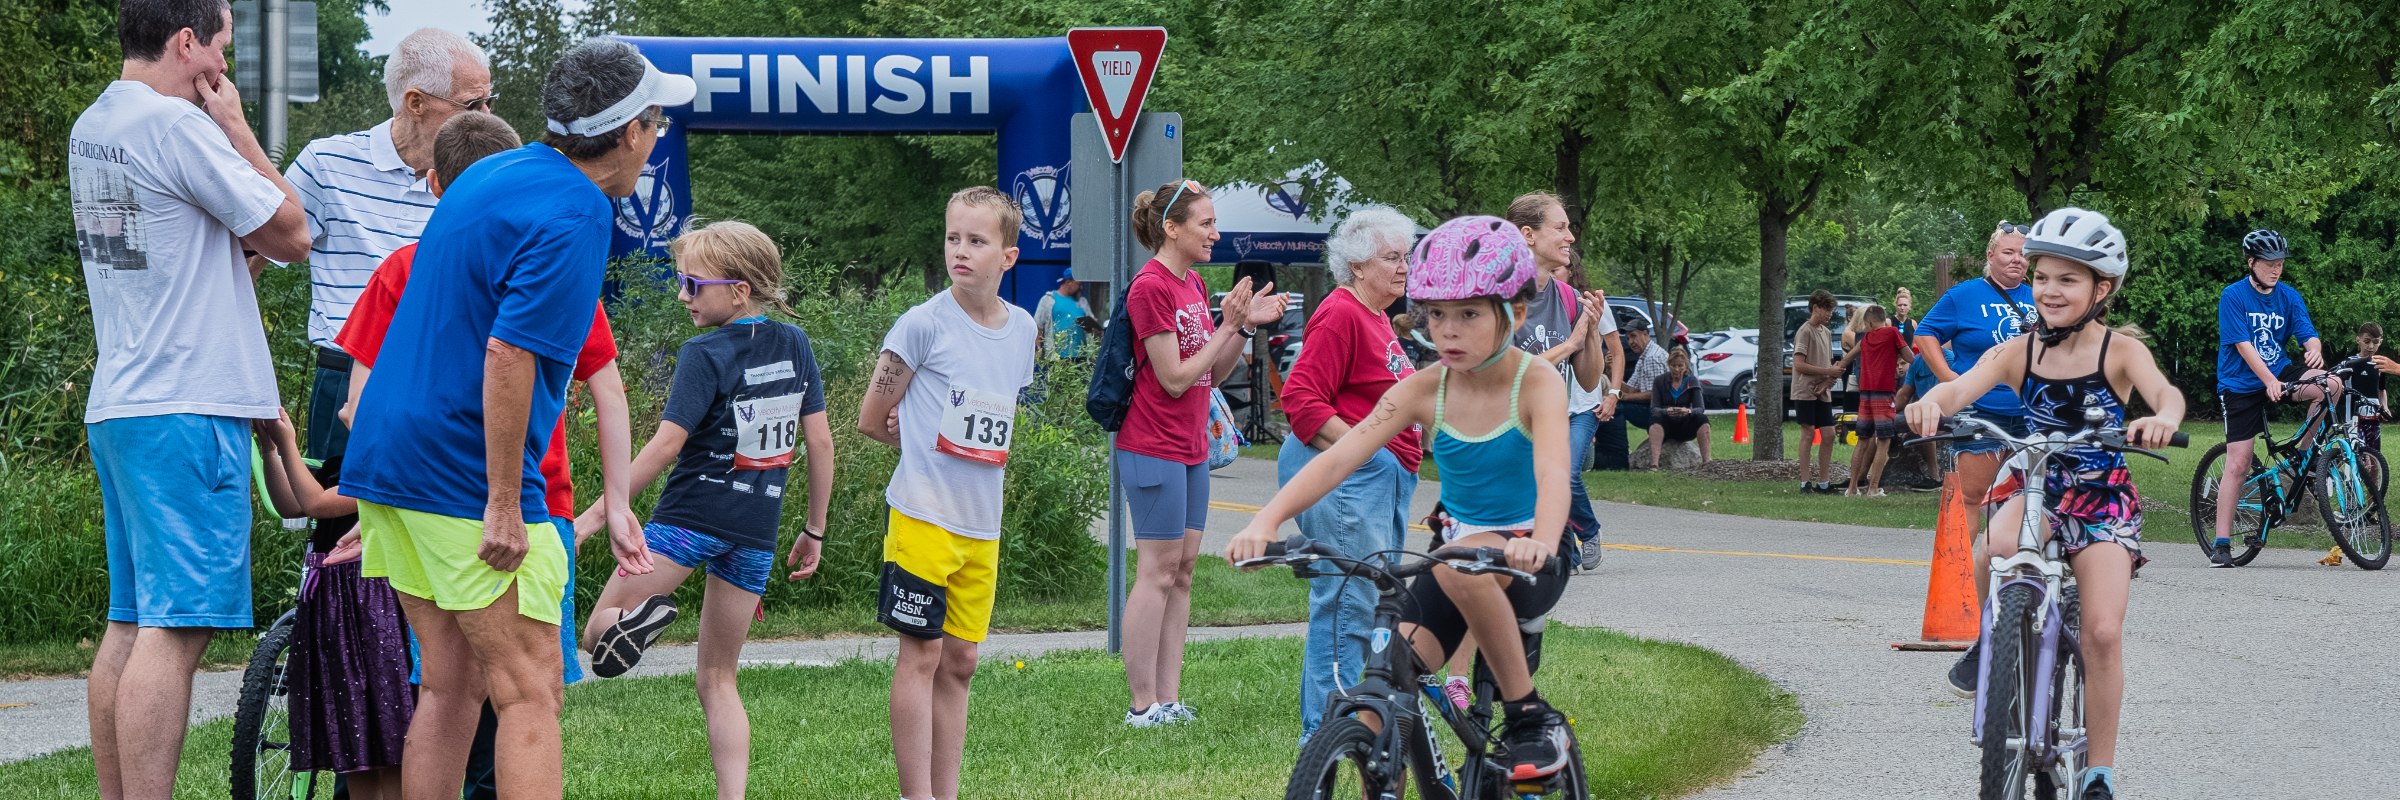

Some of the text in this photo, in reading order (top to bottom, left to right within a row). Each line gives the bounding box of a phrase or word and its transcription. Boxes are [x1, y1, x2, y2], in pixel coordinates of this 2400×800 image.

[1102, 61, 1132, 75] YIELD
[691, 54, 990, 115] FINISH
[78, 140, 129, 165] ORIGINAL
[1253, 241, 1286, 252] Velocity
[1186, 301, 1204, 313] 2017
[1981, 302, 2037, 317] I TR'D
[2249, 312, 2284, 329] TRI'D
[1520, 331, 1568, 350] IRIE TRIA
[967, 397, 993, 410] Velocity
[758, 420, 796, 451] 118
[963, 414, 1008, 447] 133
[908, 592, 933, 605] POLO
[895, 600, 924, 616] ASSN.
